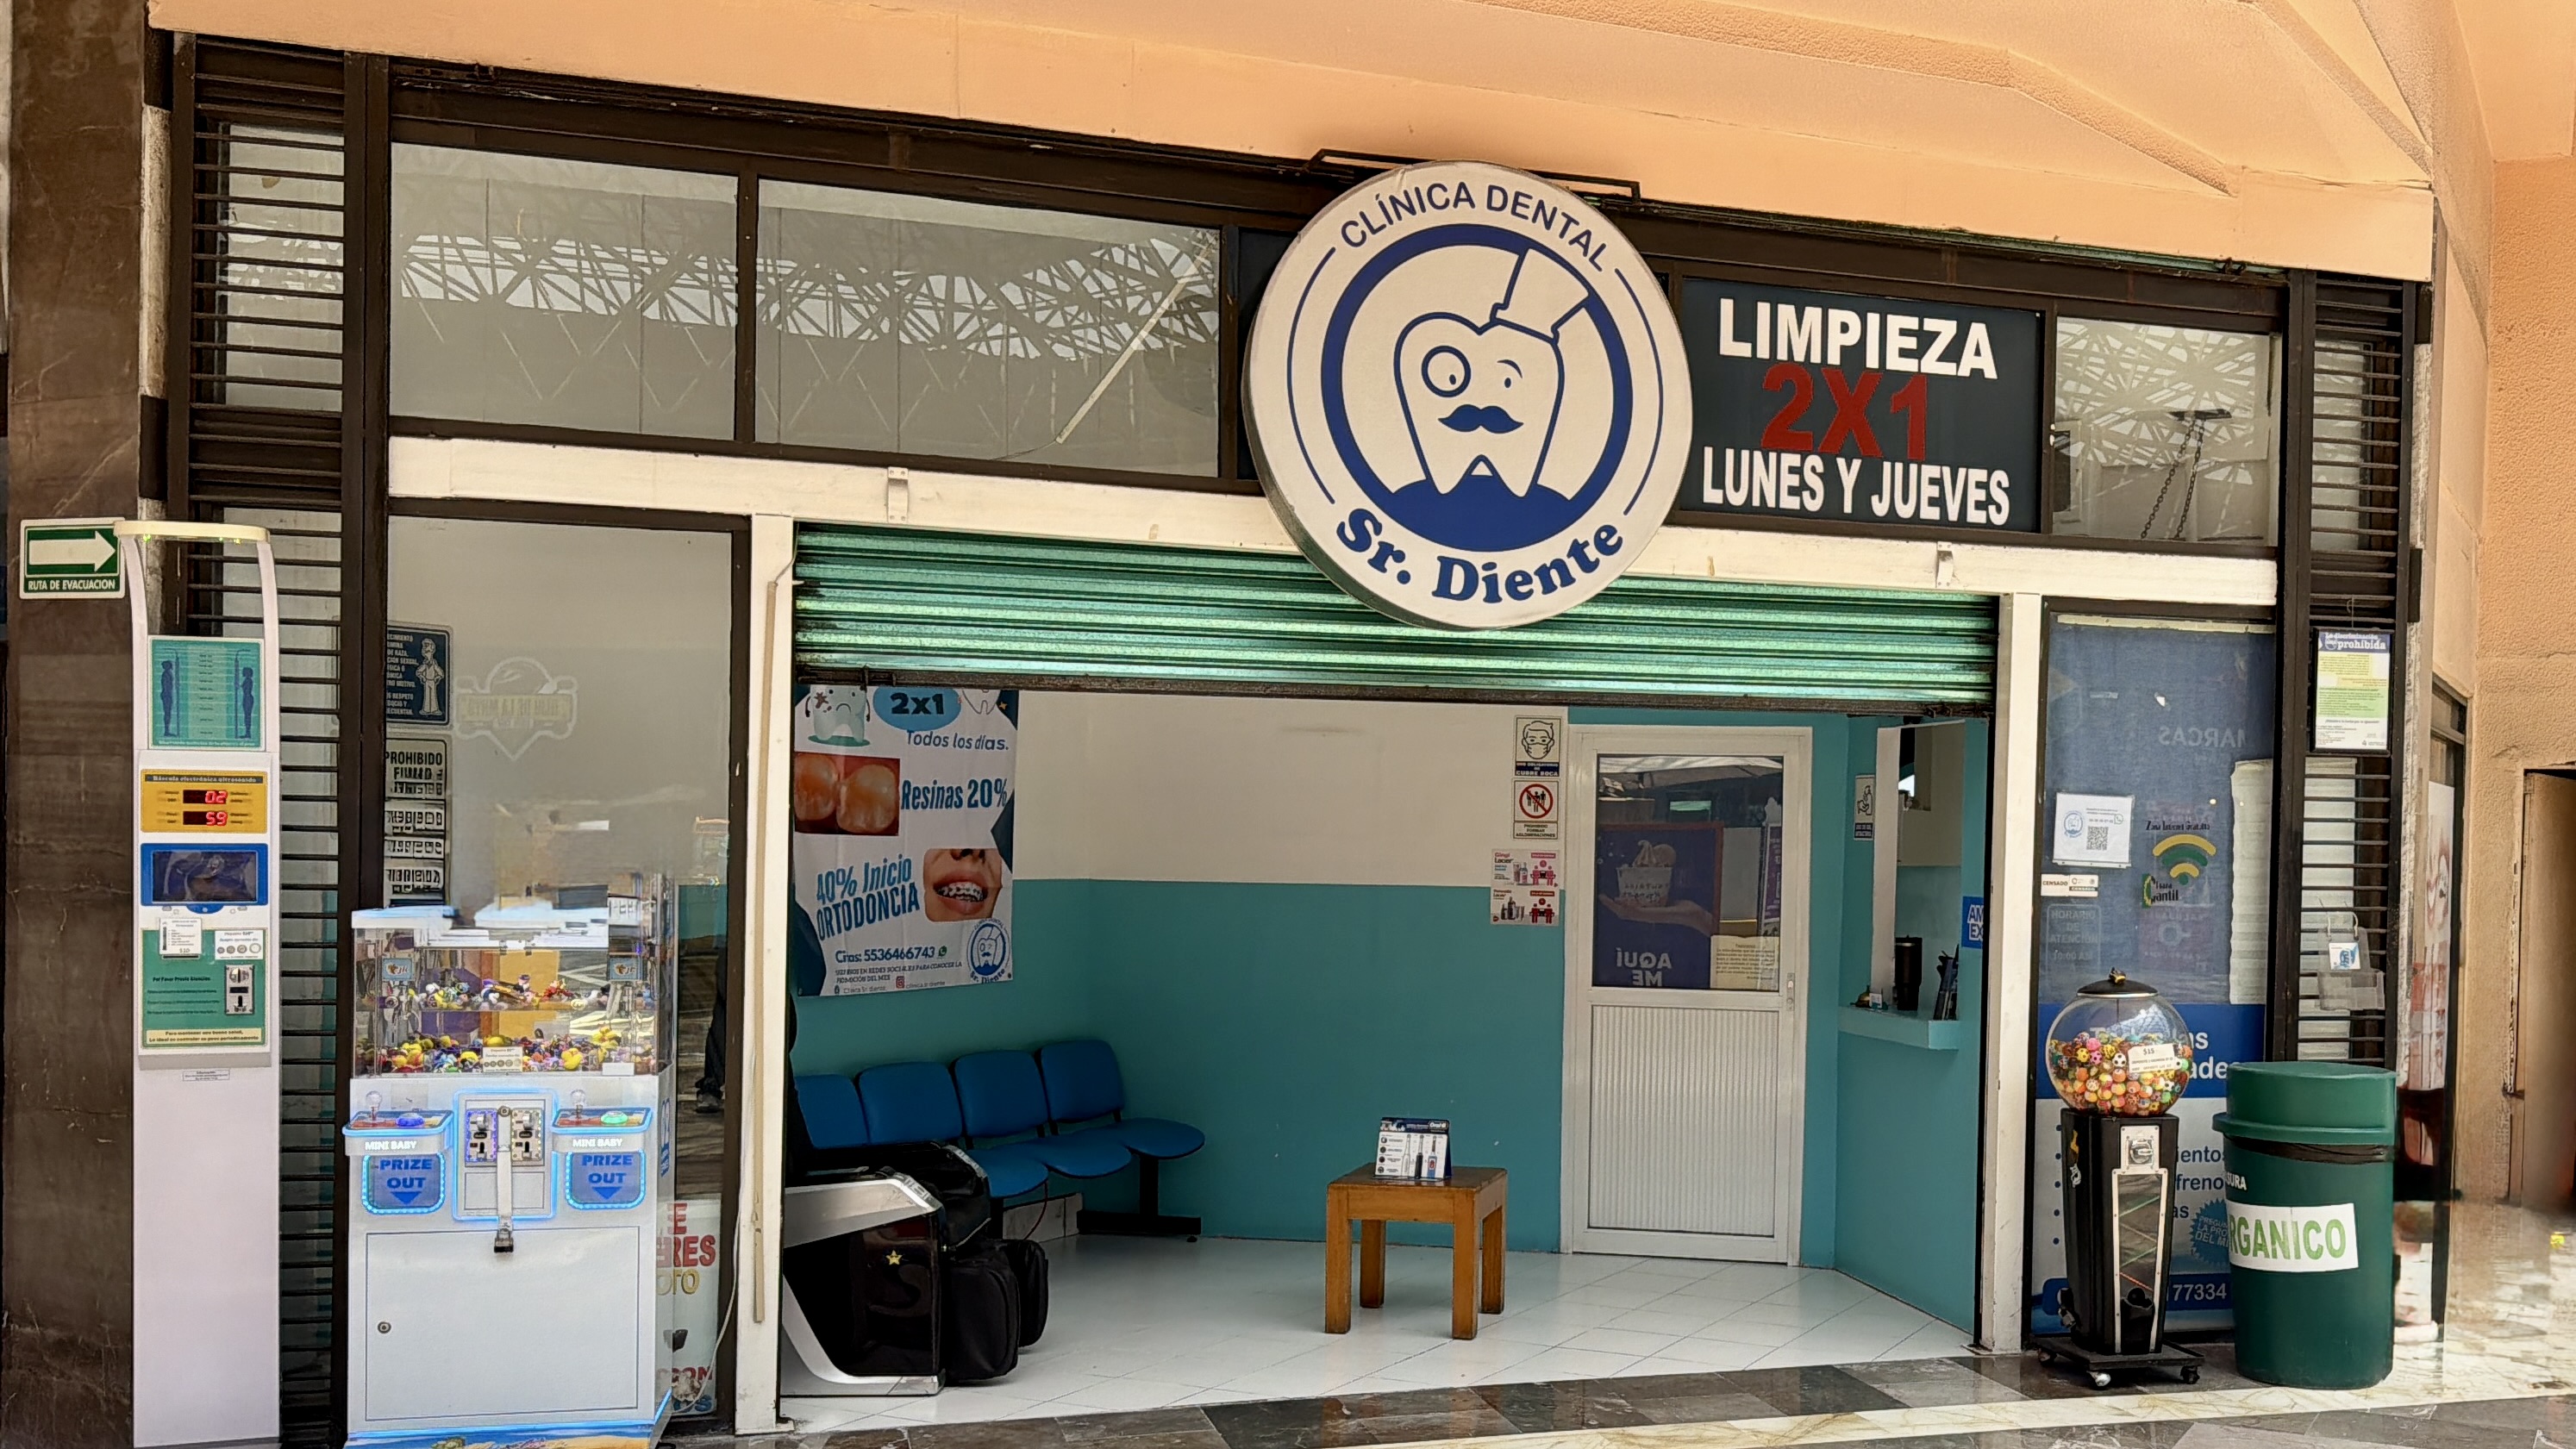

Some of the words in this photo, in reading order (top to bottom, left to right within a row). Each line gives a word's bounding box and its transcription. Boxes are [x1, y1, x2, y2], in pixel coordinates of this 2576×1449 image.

[1341, 182, 1476, 247] CLÍNICA
[1486, 184, 1606, 272] DENTAL
[1719, 297, 1998, 379] LIMPIEZA
[1761, 362, 1928, 461] 2X1
[1703, 447, 1824, 512] LUNES
[1835, 457, 1861, 514] Y
[1871, 460, 2010, 526] JUEVES
[1336, 508, 1411, 585] Sr.
[1431, 524, 1623, 603] Diente
[28, 580, 47, 590] RUTA
[49, 580, 60, 590] DE
[62, 579, 116, 590] EVACUACION
[2337, 639, 2385, 650] prohibida
[891, 693, 944, 715] 2x1
[907, 729, 949, 747] Todos
[953, 733, 972, 748] los
[975, 734, 1010, 751] días.
[901, 779, 964, 809] Resinas
[967, 778, 1008, 809] 20%
[206, 811, 228, 826] 59
[816, 865, 858, 905] 40%
[862, 853, 912, 893] Inicio
[816, 881, 921, 941] ORTODONCIA
[864, 946, 935, 962] 5536466743
[365, 1141, 390, 1151] MINI
[391, 1140, 417, 1150] BABY
[572, 1139, 599, 1148] MINI
[600, 1138, 623, 1148] BABY
[581, 1154, 634, 1166] PRIZE
[2176, 1146, 2224, 1163] iento
[379, 1159, 432, 1171] PRIZE
[387, 1177, 426, 1189] OUT
[588, 1172, 627, 1184] OUT
[2195, 1231, 2215, 1244] DEL
